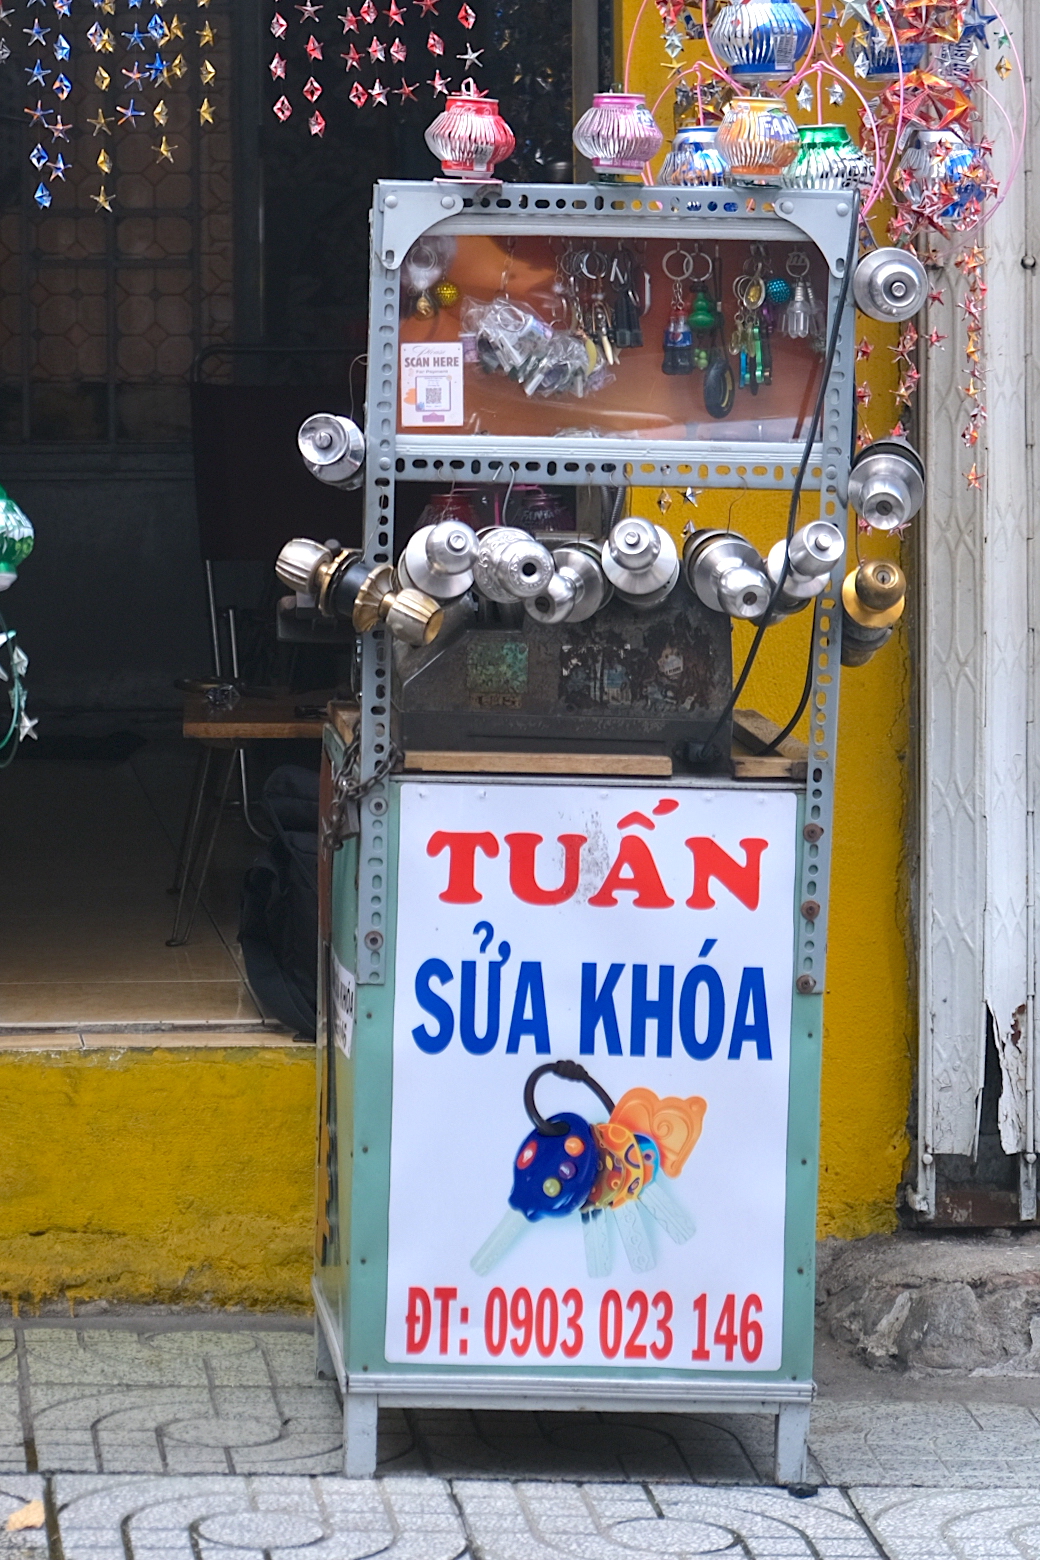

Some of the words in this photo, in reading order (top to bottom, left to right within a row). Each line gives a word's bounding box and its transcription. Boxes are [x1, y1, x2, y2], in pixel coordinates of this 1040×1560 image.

[404, 356, 430, 368] SCAN
[433, 356, 459, 367] HERE
[426, 798, 769, 912] TUẤN
[411, 921, 551, 1056] SỬA
[579, 939, 773, 1061] KHÓA
[405, 1287, 469, 1356] ĐT:
[484, 1287, 584, 1358] 0903
[599, 1289, 674, 1360] 023
[691, 1292, 763, 1363] 146
